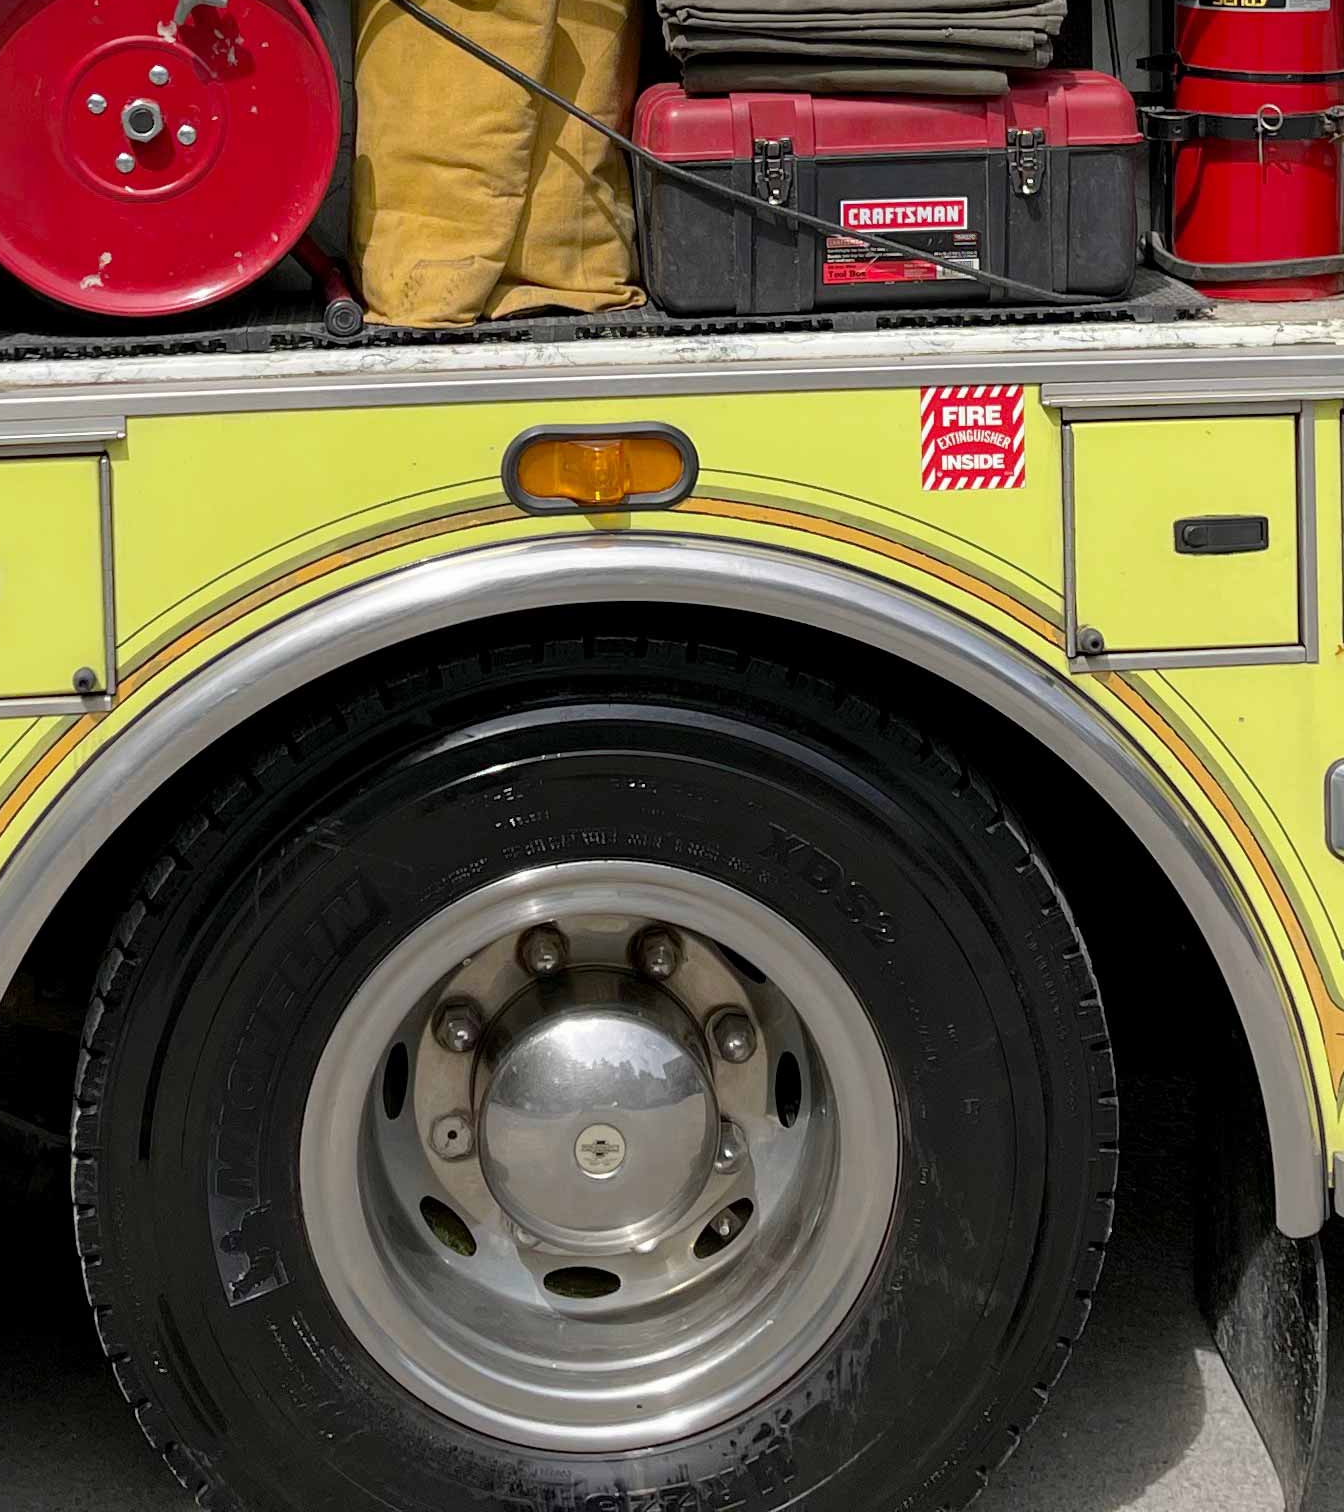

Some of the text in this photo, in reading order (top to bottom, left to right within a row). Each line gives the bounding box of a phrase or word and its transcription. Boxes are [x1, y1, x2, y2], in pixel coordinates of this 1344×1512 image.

[847, 206, 960, 226] CRAFTSMAN
[942, 405, 1003, 427] FIRE
[936, 429, 1011, 450] EXTINGUISHER
[941, 453, 1005, 471] INSIDE
[213, 878, 378, 1200] MICHELIN
